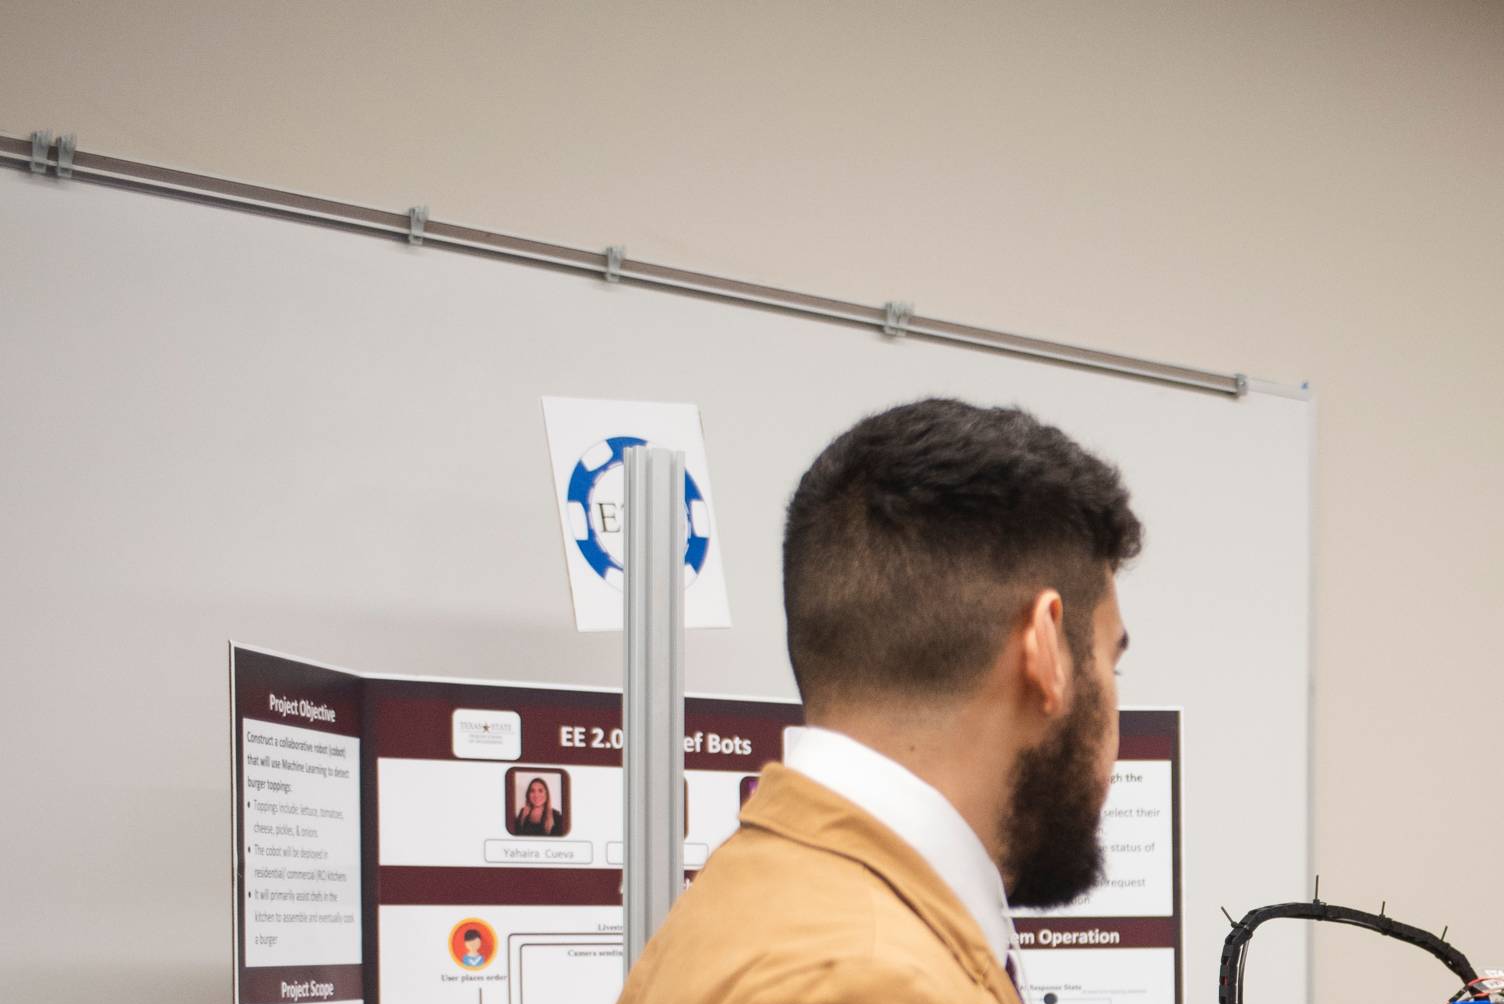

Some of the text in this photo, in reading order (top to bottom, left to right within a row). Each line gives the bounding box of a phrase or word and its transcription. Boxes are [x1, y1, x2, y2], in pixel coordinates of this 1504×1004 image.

[597, 502, 623, 534] E
[269, 693, 336, 723] Project Objective
[560, 726, 586, 748] EE
[684, 732, 703, 753] ef
[707, 734, 752, 755] Bots
[1125, 773, 1143, 783] the
[1104, 808, 1133, 817] select
[503, 848, 574, 859] Yahaira Cueva
[1110, 843, 1155, 852] status of
[1038, 928, 1120, 946] Operation
[281, 980, 334, 1002] Project Scope
